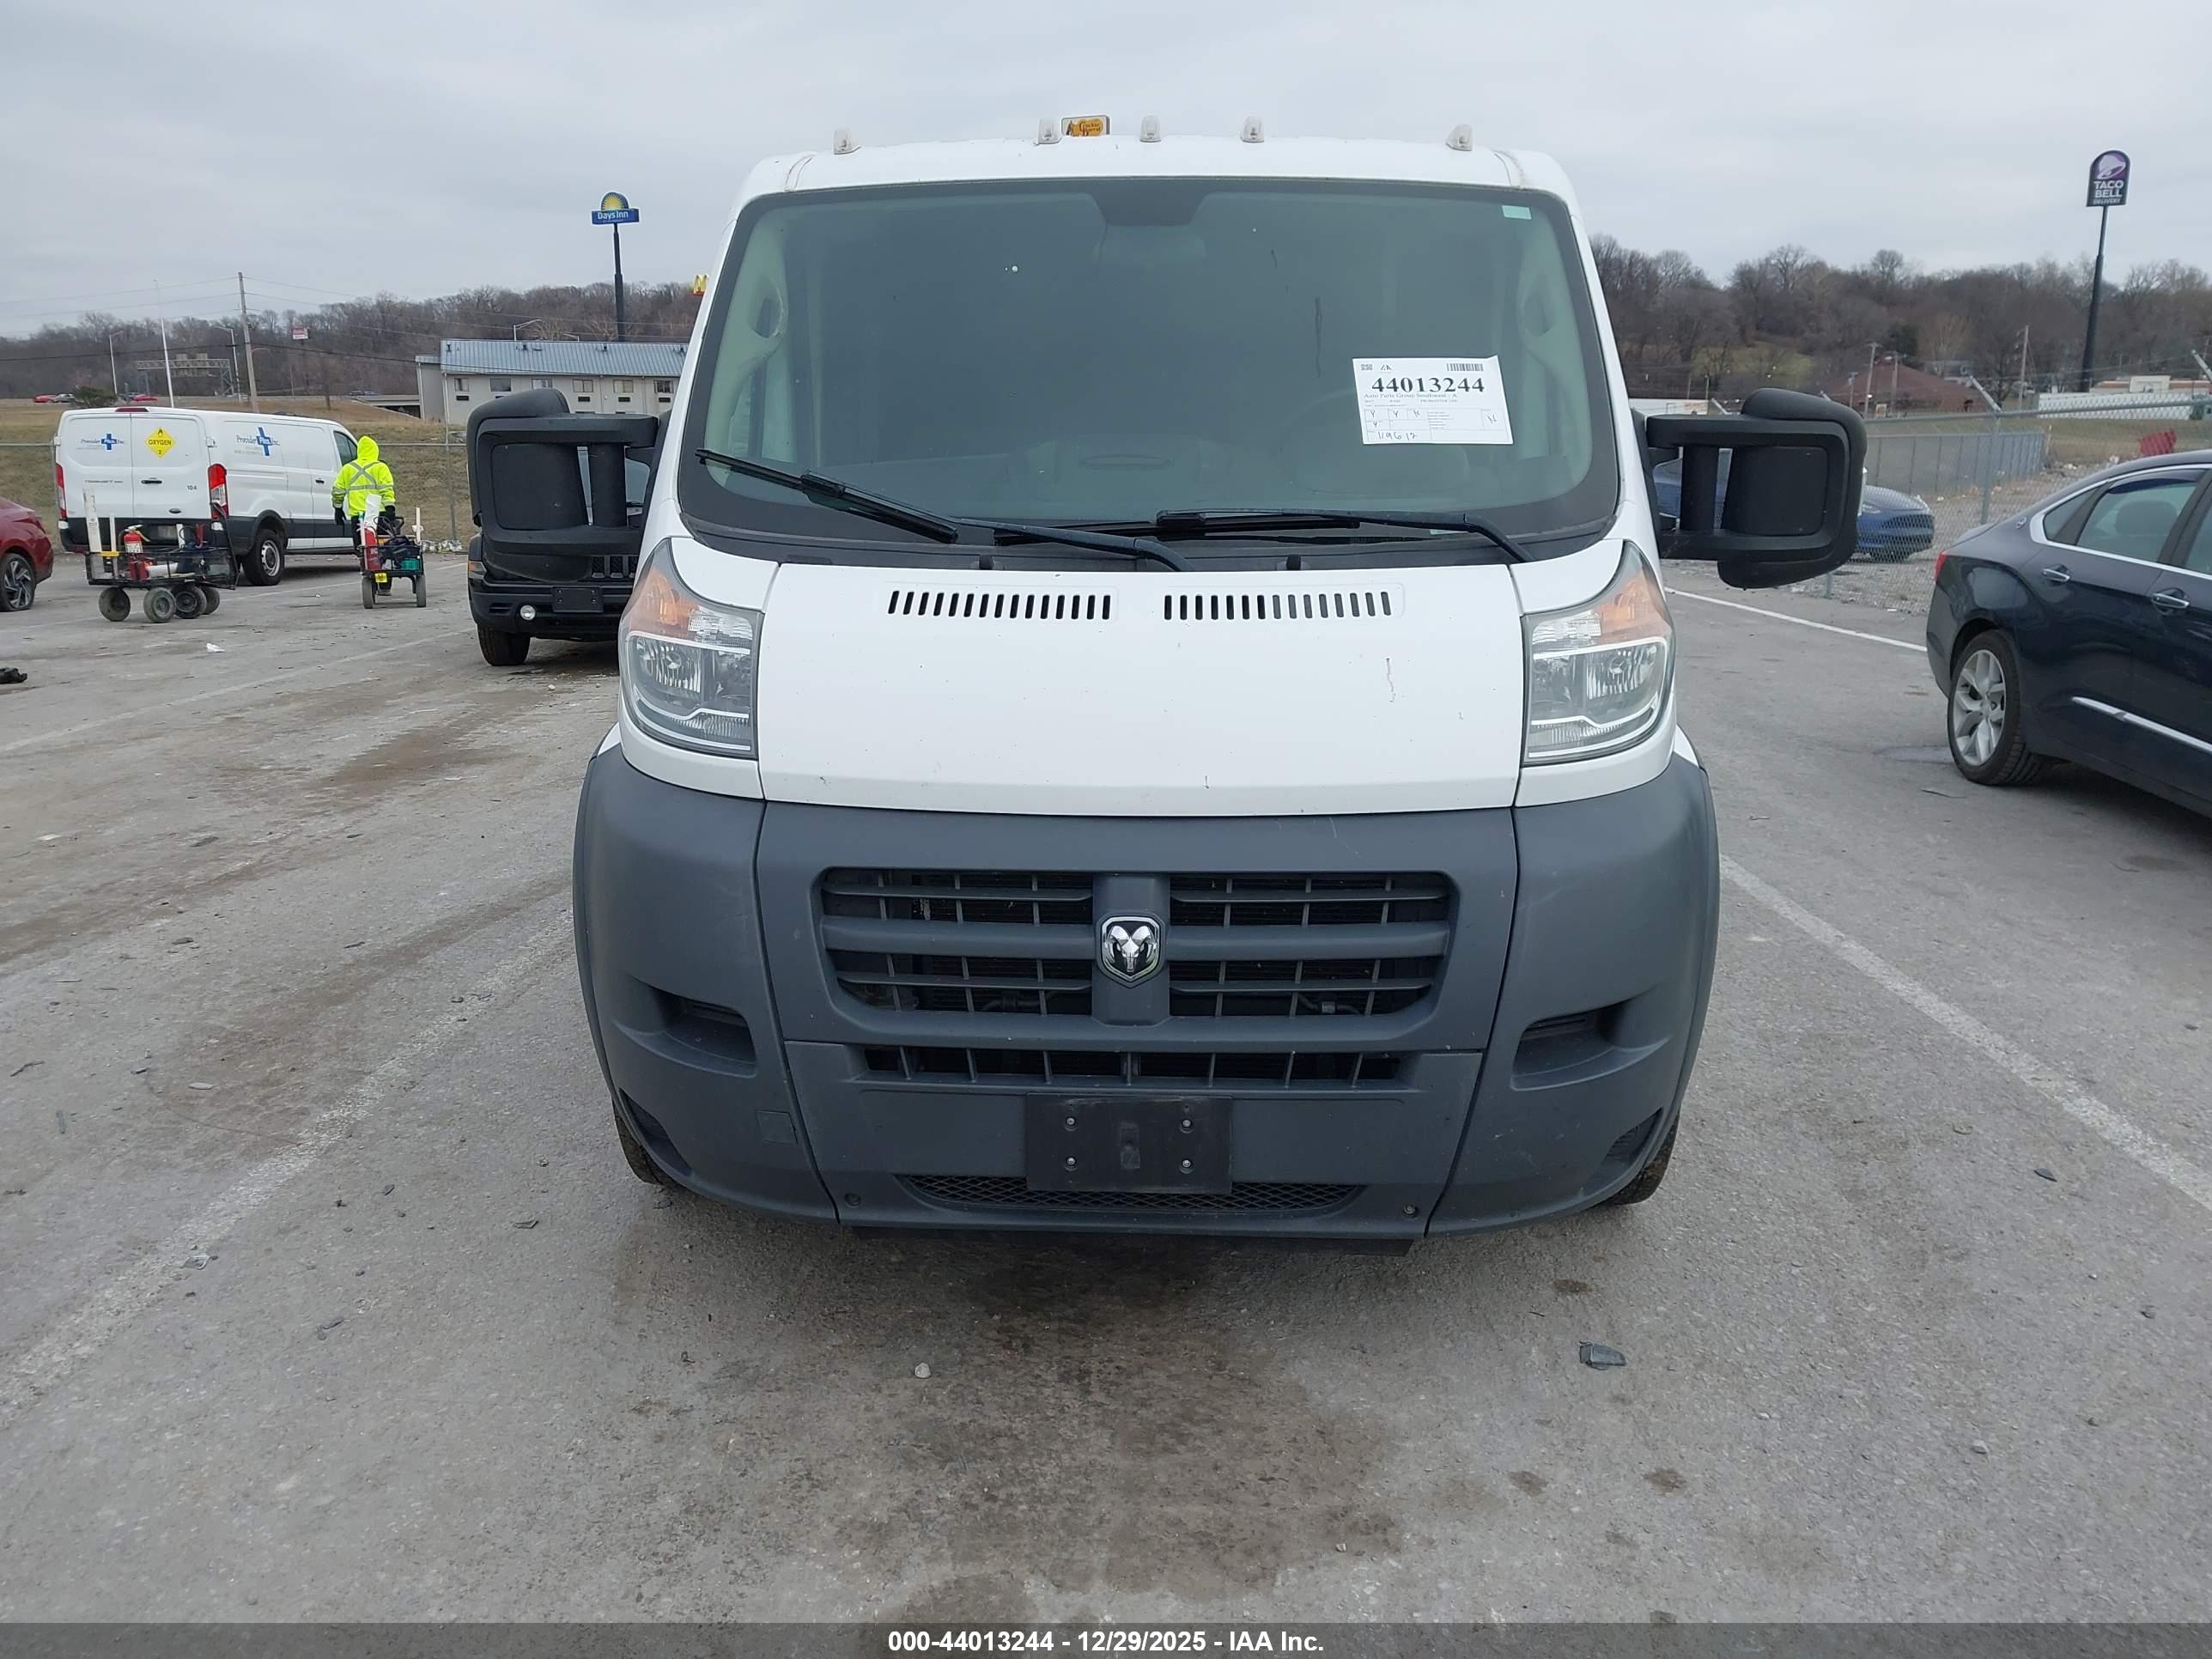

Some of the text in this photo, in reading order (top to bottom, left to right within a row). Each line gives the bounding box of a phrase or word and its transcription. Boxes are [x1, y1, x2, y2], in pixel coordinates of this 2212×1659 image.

[2094, 180, 2124, 189] TACO
[2094, 189, 2123, 198] BELL
[597, 211, 616, 220] Days
[1371, 377, 1485, 392] 44013244
